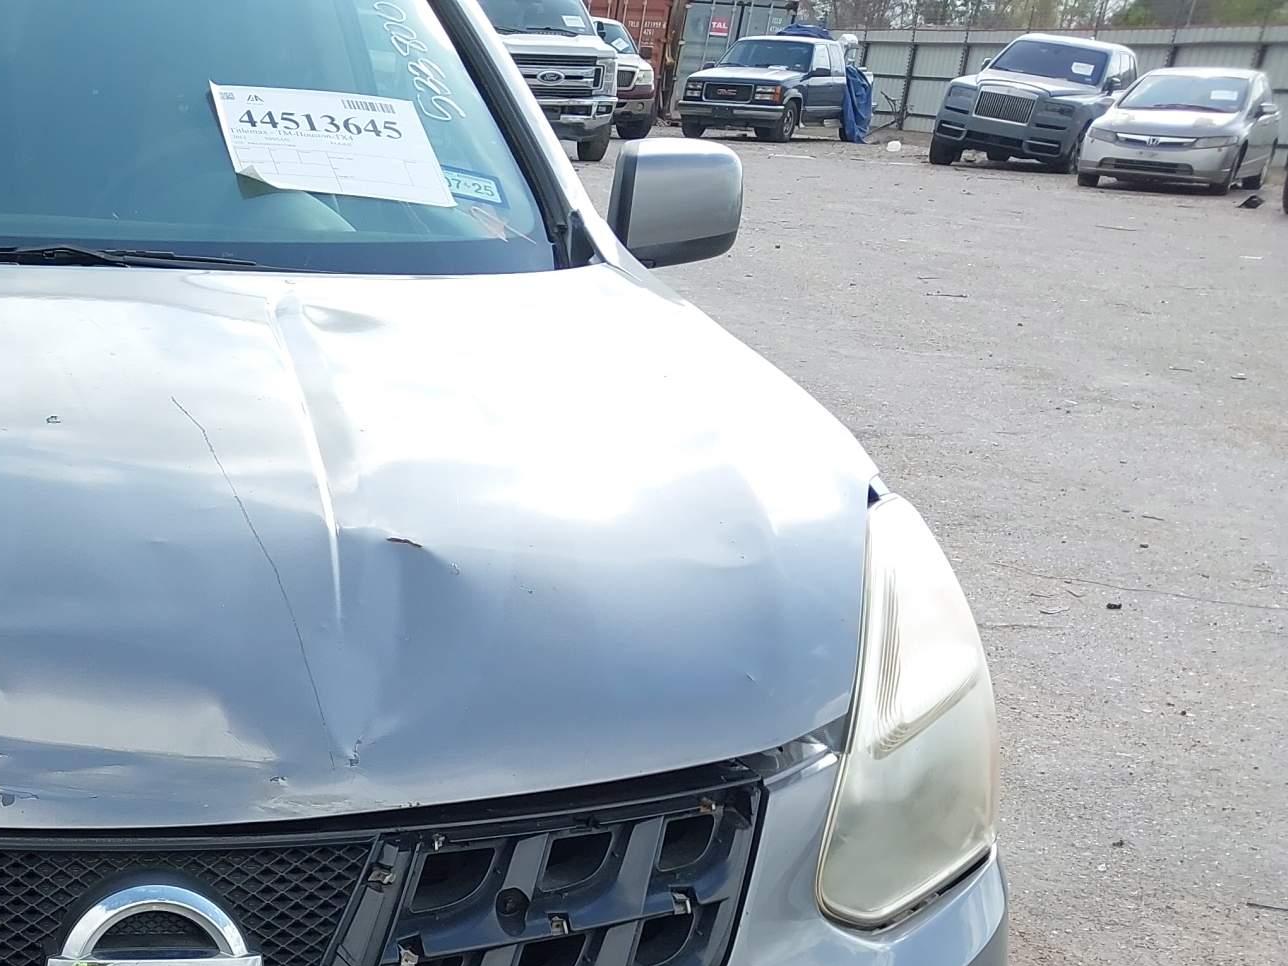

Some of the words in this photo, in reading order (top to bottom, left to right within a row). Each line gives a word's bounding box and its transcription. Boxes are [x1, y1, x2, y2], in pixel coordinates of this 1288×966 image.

[711, 21, 728, 29] TAL
[238, 109, 402, 140] 44513645
[472, 182, 495, 197] 25
